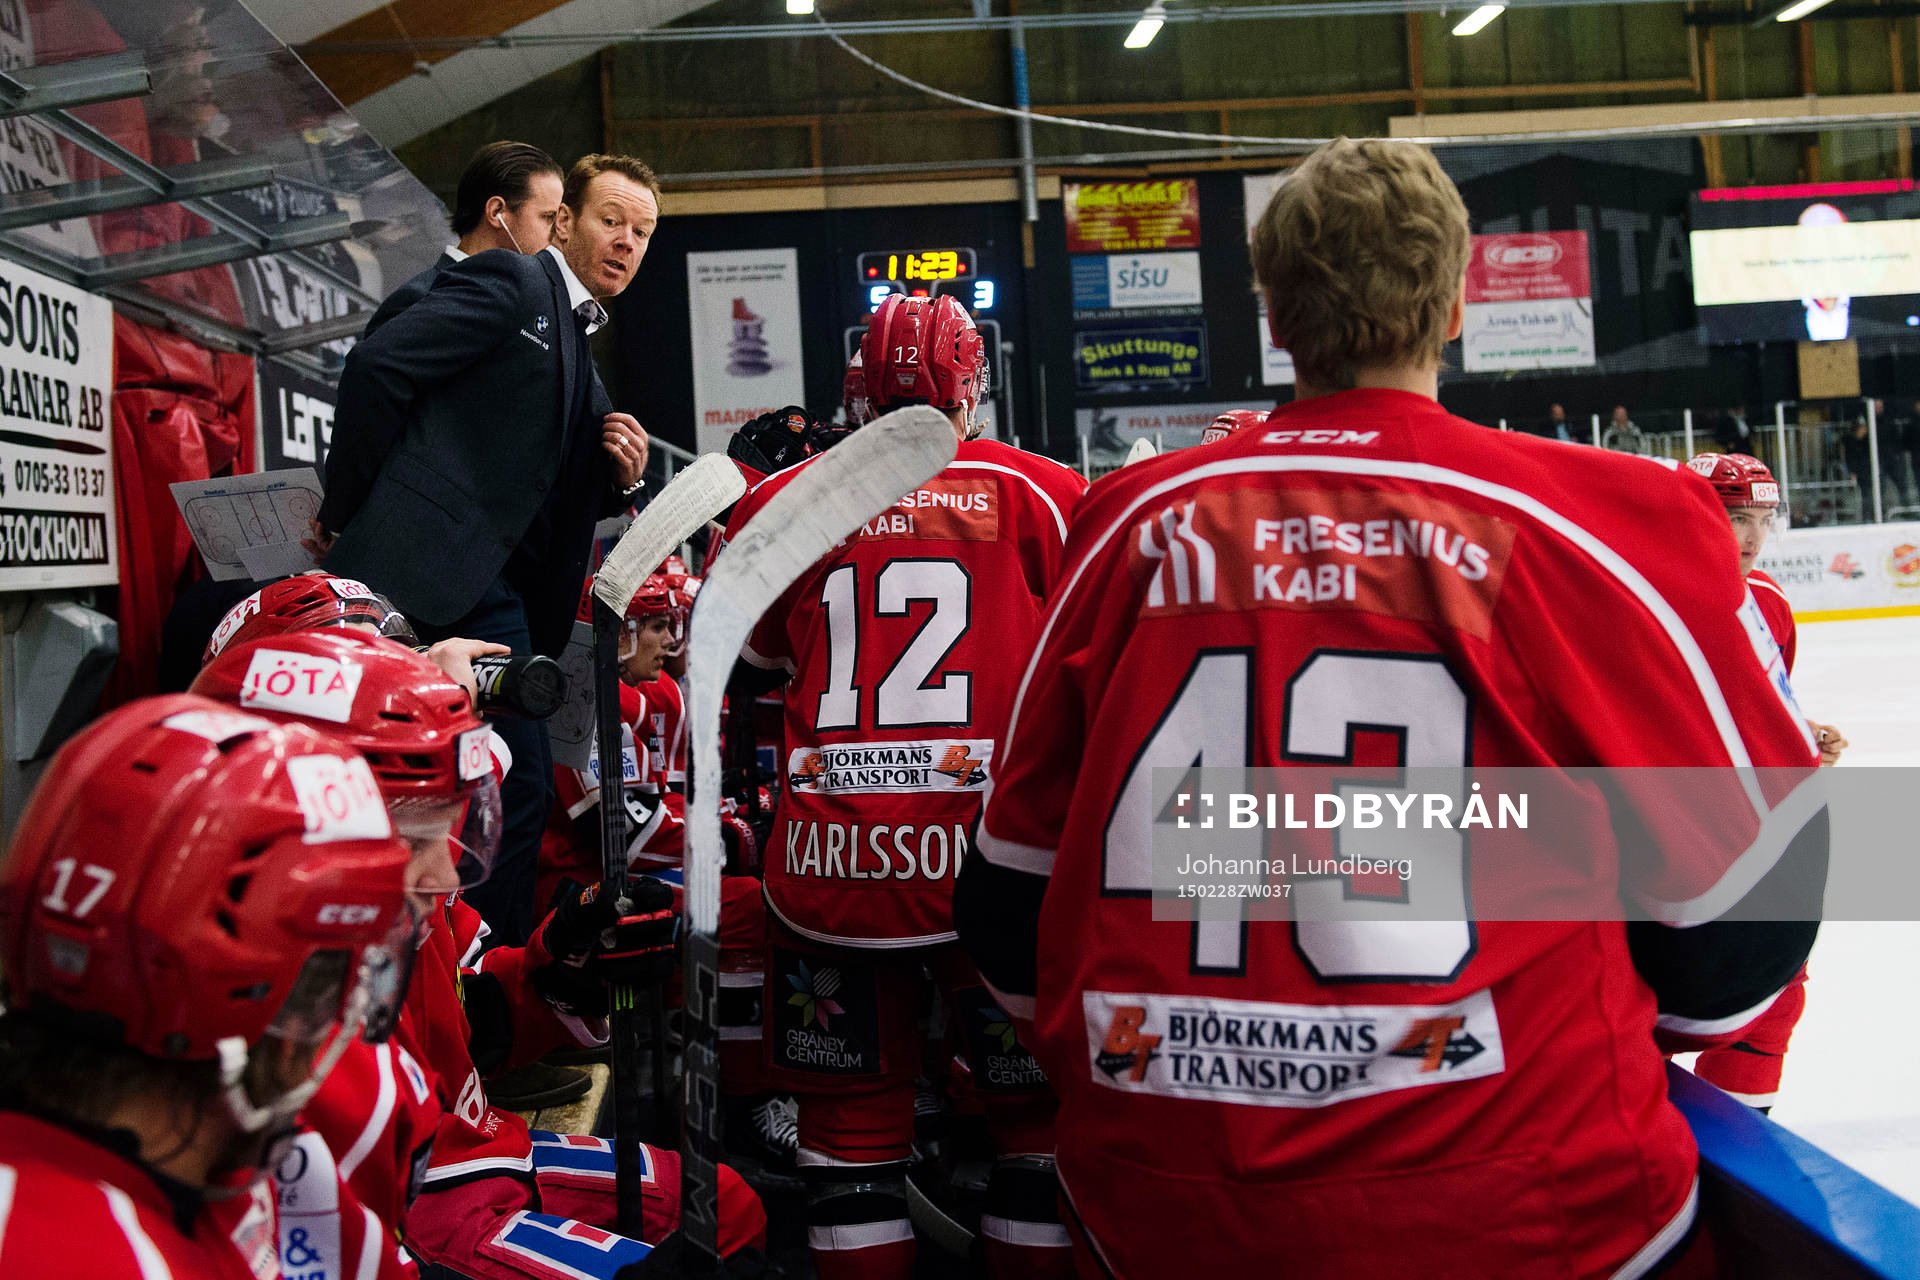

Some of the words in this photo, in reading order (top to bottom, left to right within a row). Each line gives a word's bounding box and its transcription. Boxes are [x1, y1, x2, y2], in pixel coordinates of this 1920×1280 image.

[887, 251, 958, 281] 11:23
[870, 285, 891, 314] 5
[973, 281, 994, 309] 3
[895, 346, 918, 363] 12
[1081, 339, 1198, 363] Skuttunge
[78, 385, 104, 432] AB
[1262, 429, 1380, 445] CCM
[15, 459, 69, 495] 0705-33
[74, 466, 88, 497] 13
[91, 468, 105, 497] 37
[890, 490, 989, 512] SENIUS
[1254, 514, 1490, 581] FRESENIUS
[1253, 563, 1357, 604] KABI
[815, 557, 973, 734] 12
[246, 660, 350, 701] JÖTA
[824, 749, 932, 770] BJÖRKMANS
[824, 768, 931, 787] TRANSPORT
[1102, 645, 1478, 984] 43
[786, 820, 968, 880] KARLSSON
[43, 857, 117, 918] 17
[786, 1029, 847, 1052] GRÄNBY
[1168, 1011, 1377, 1054] BJÖRKMANS
[786, 1045, 862, 1068] CENTRUM
[1169, 1052, 1369, 1093] TRANSPORT
